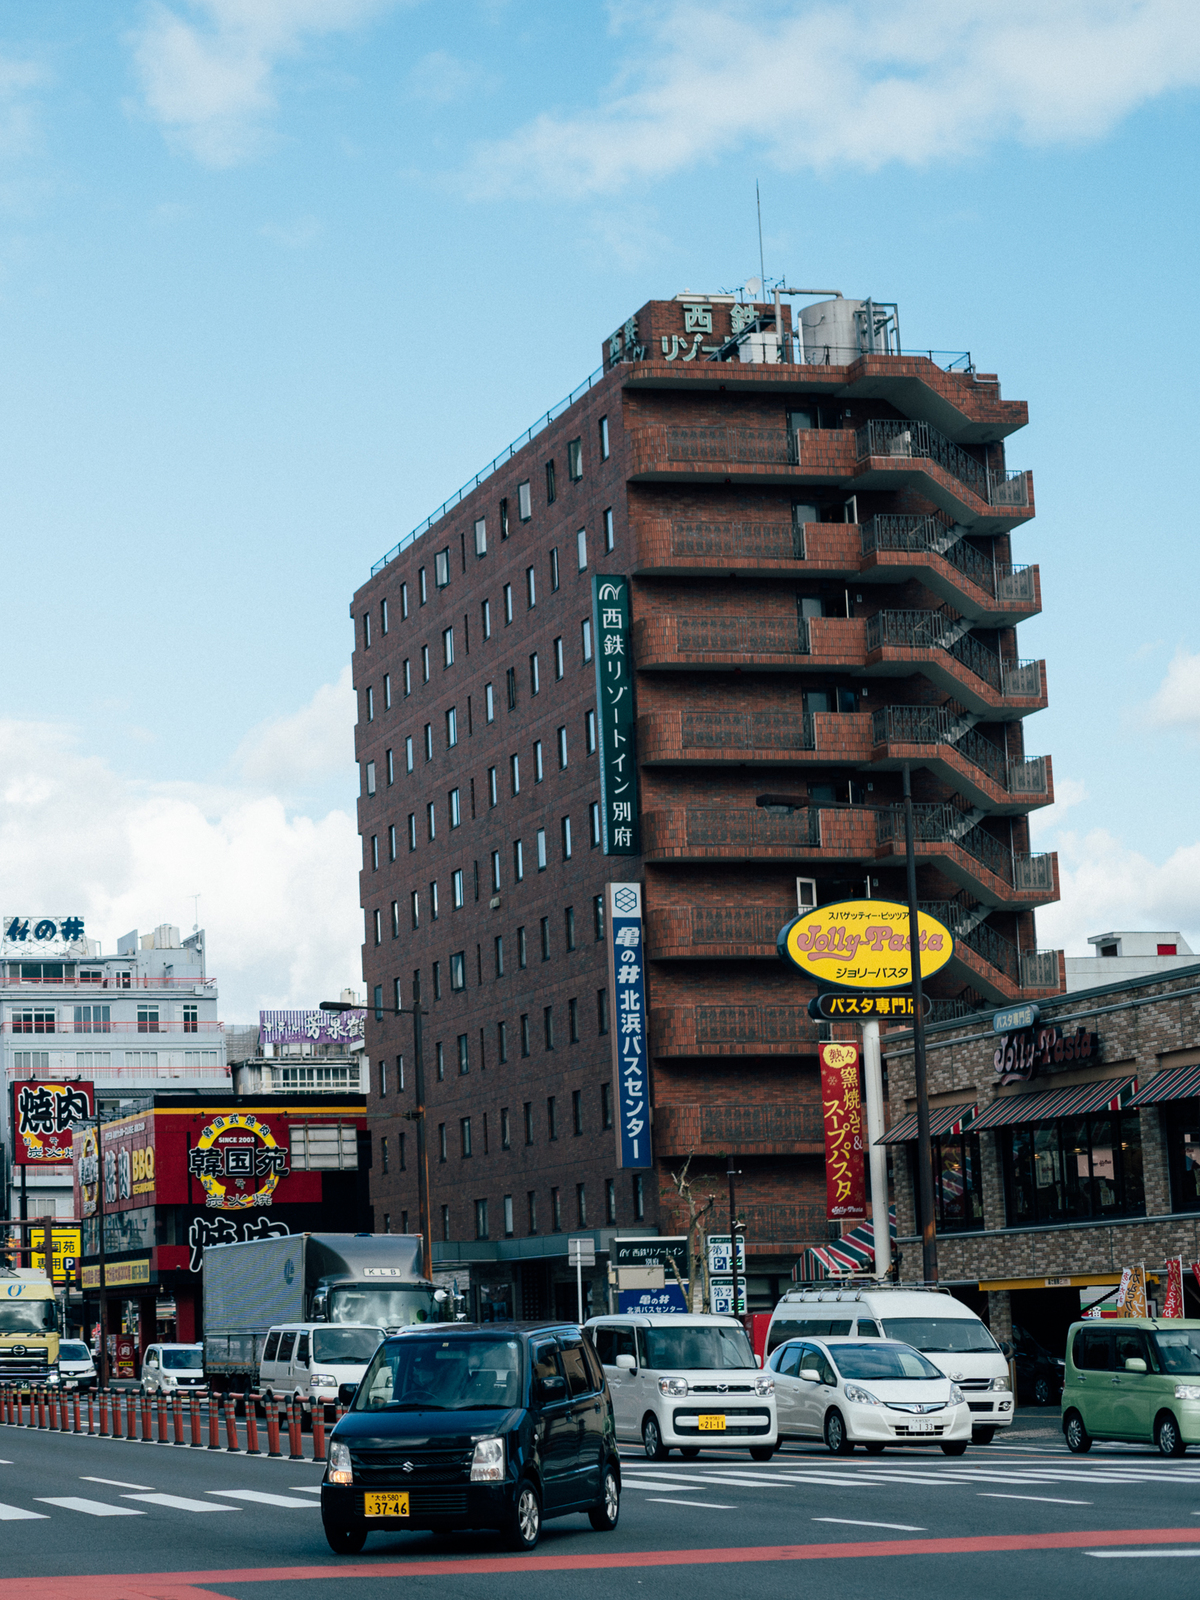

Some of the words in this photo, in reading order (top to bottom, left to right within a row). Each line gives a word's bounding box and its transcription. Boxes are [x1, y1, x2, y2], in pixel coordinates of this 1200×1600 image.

[602, 608, 633, 847] 西鉄リゾートイン別府
[836, 968, 909, 979] ジョリーパスタ
[620, 989, 644, 1159] 北浜バスセンター
[18, 1085, 90, 1135] 焼肉
[218, 1136, 237, 1144] SINCE
[238, 1136, 255, 1144] 2003
[823, 1099, 853, 1203] スープパスタ
[132, 1145, 154, 1182] BBQ
[189, 1146, 289, 1179] 韓国苑
[206, 1192, 273, 1208] 炭火焼
[65, 1258, 74, 1269] P
[639, 1294, 670, 1306] 亀の井
[375, 1502, 407, 1515] 37-46
